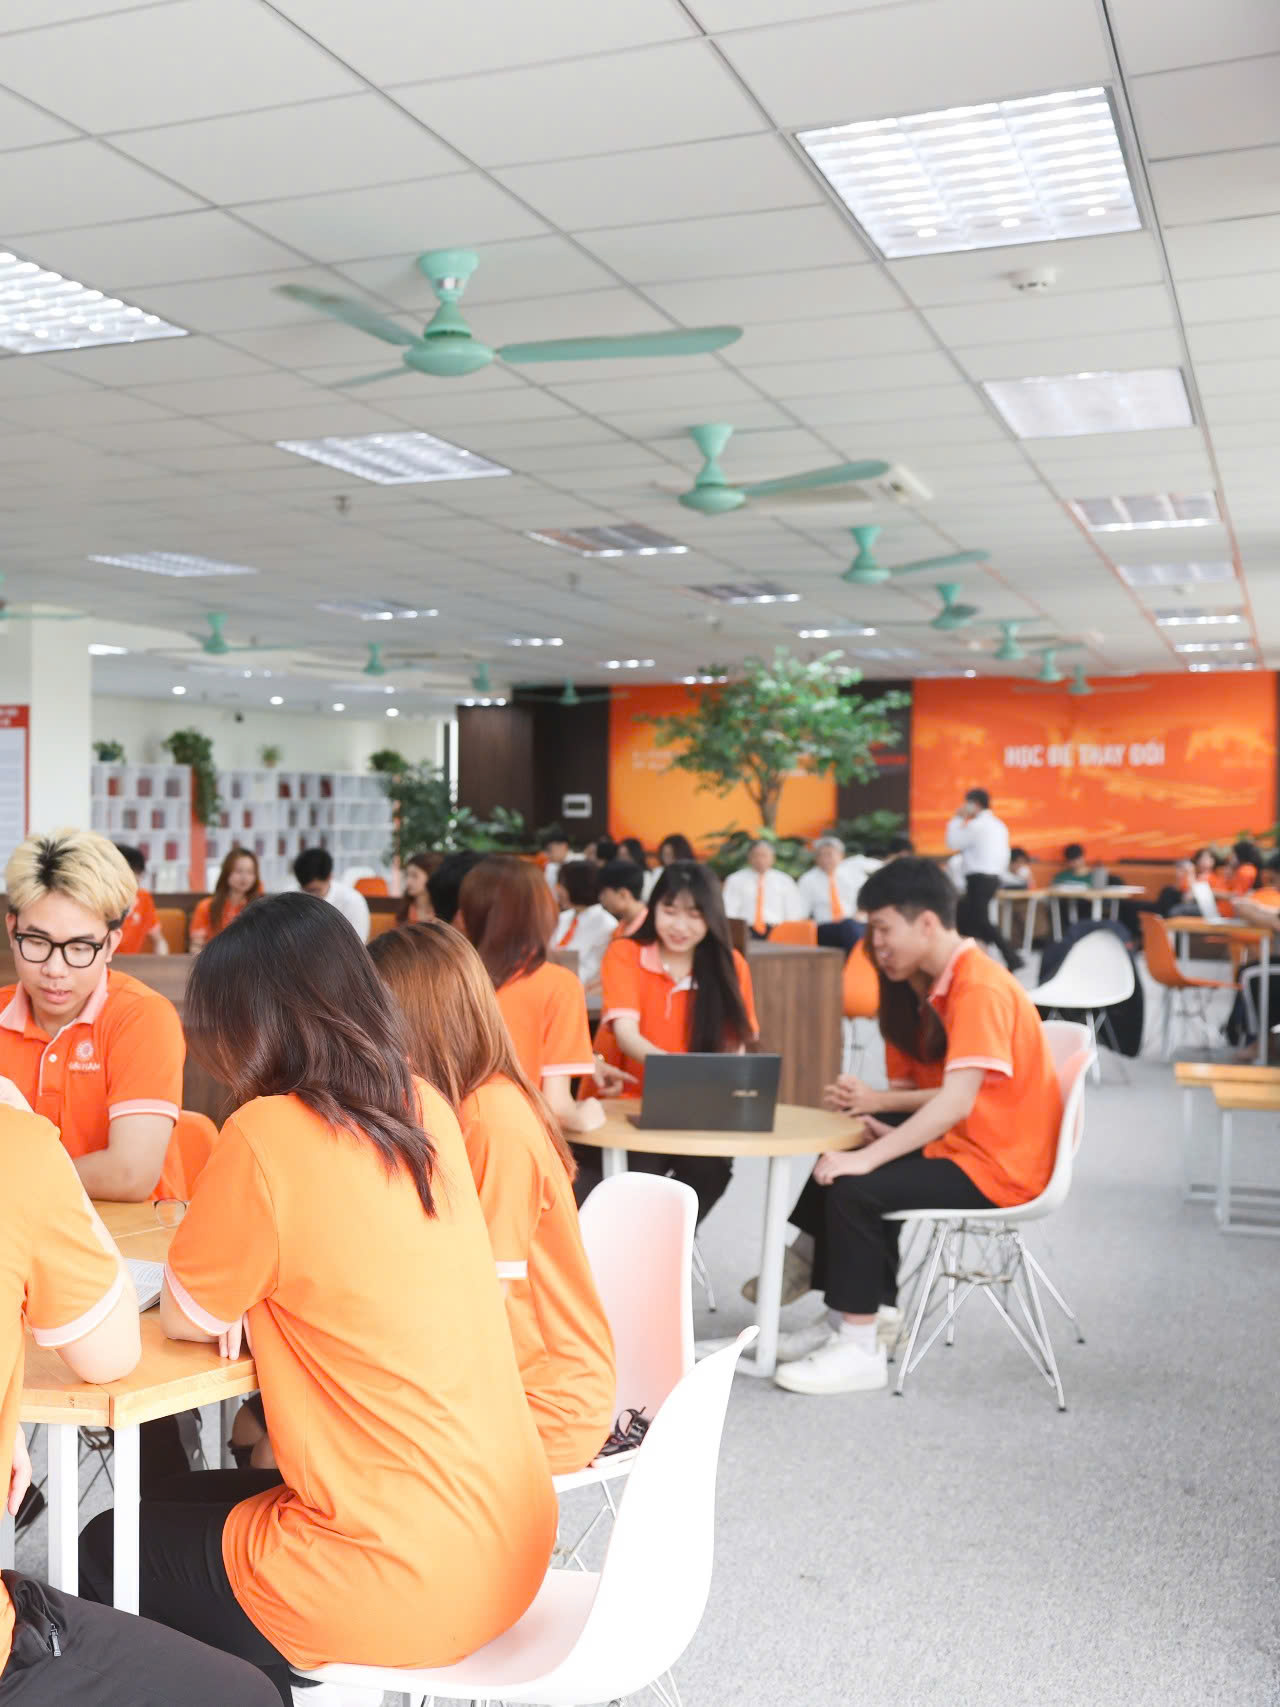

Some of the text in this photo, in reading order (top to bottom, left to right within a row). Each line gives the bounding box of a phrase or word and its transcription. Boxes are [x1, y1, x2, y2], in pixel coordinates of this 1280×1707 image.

[1005, 746, 1043, 771] HỌC
[1048, 742, 1072, 767] ĐỂ
[1080, 744, 1125, 766] THAY
